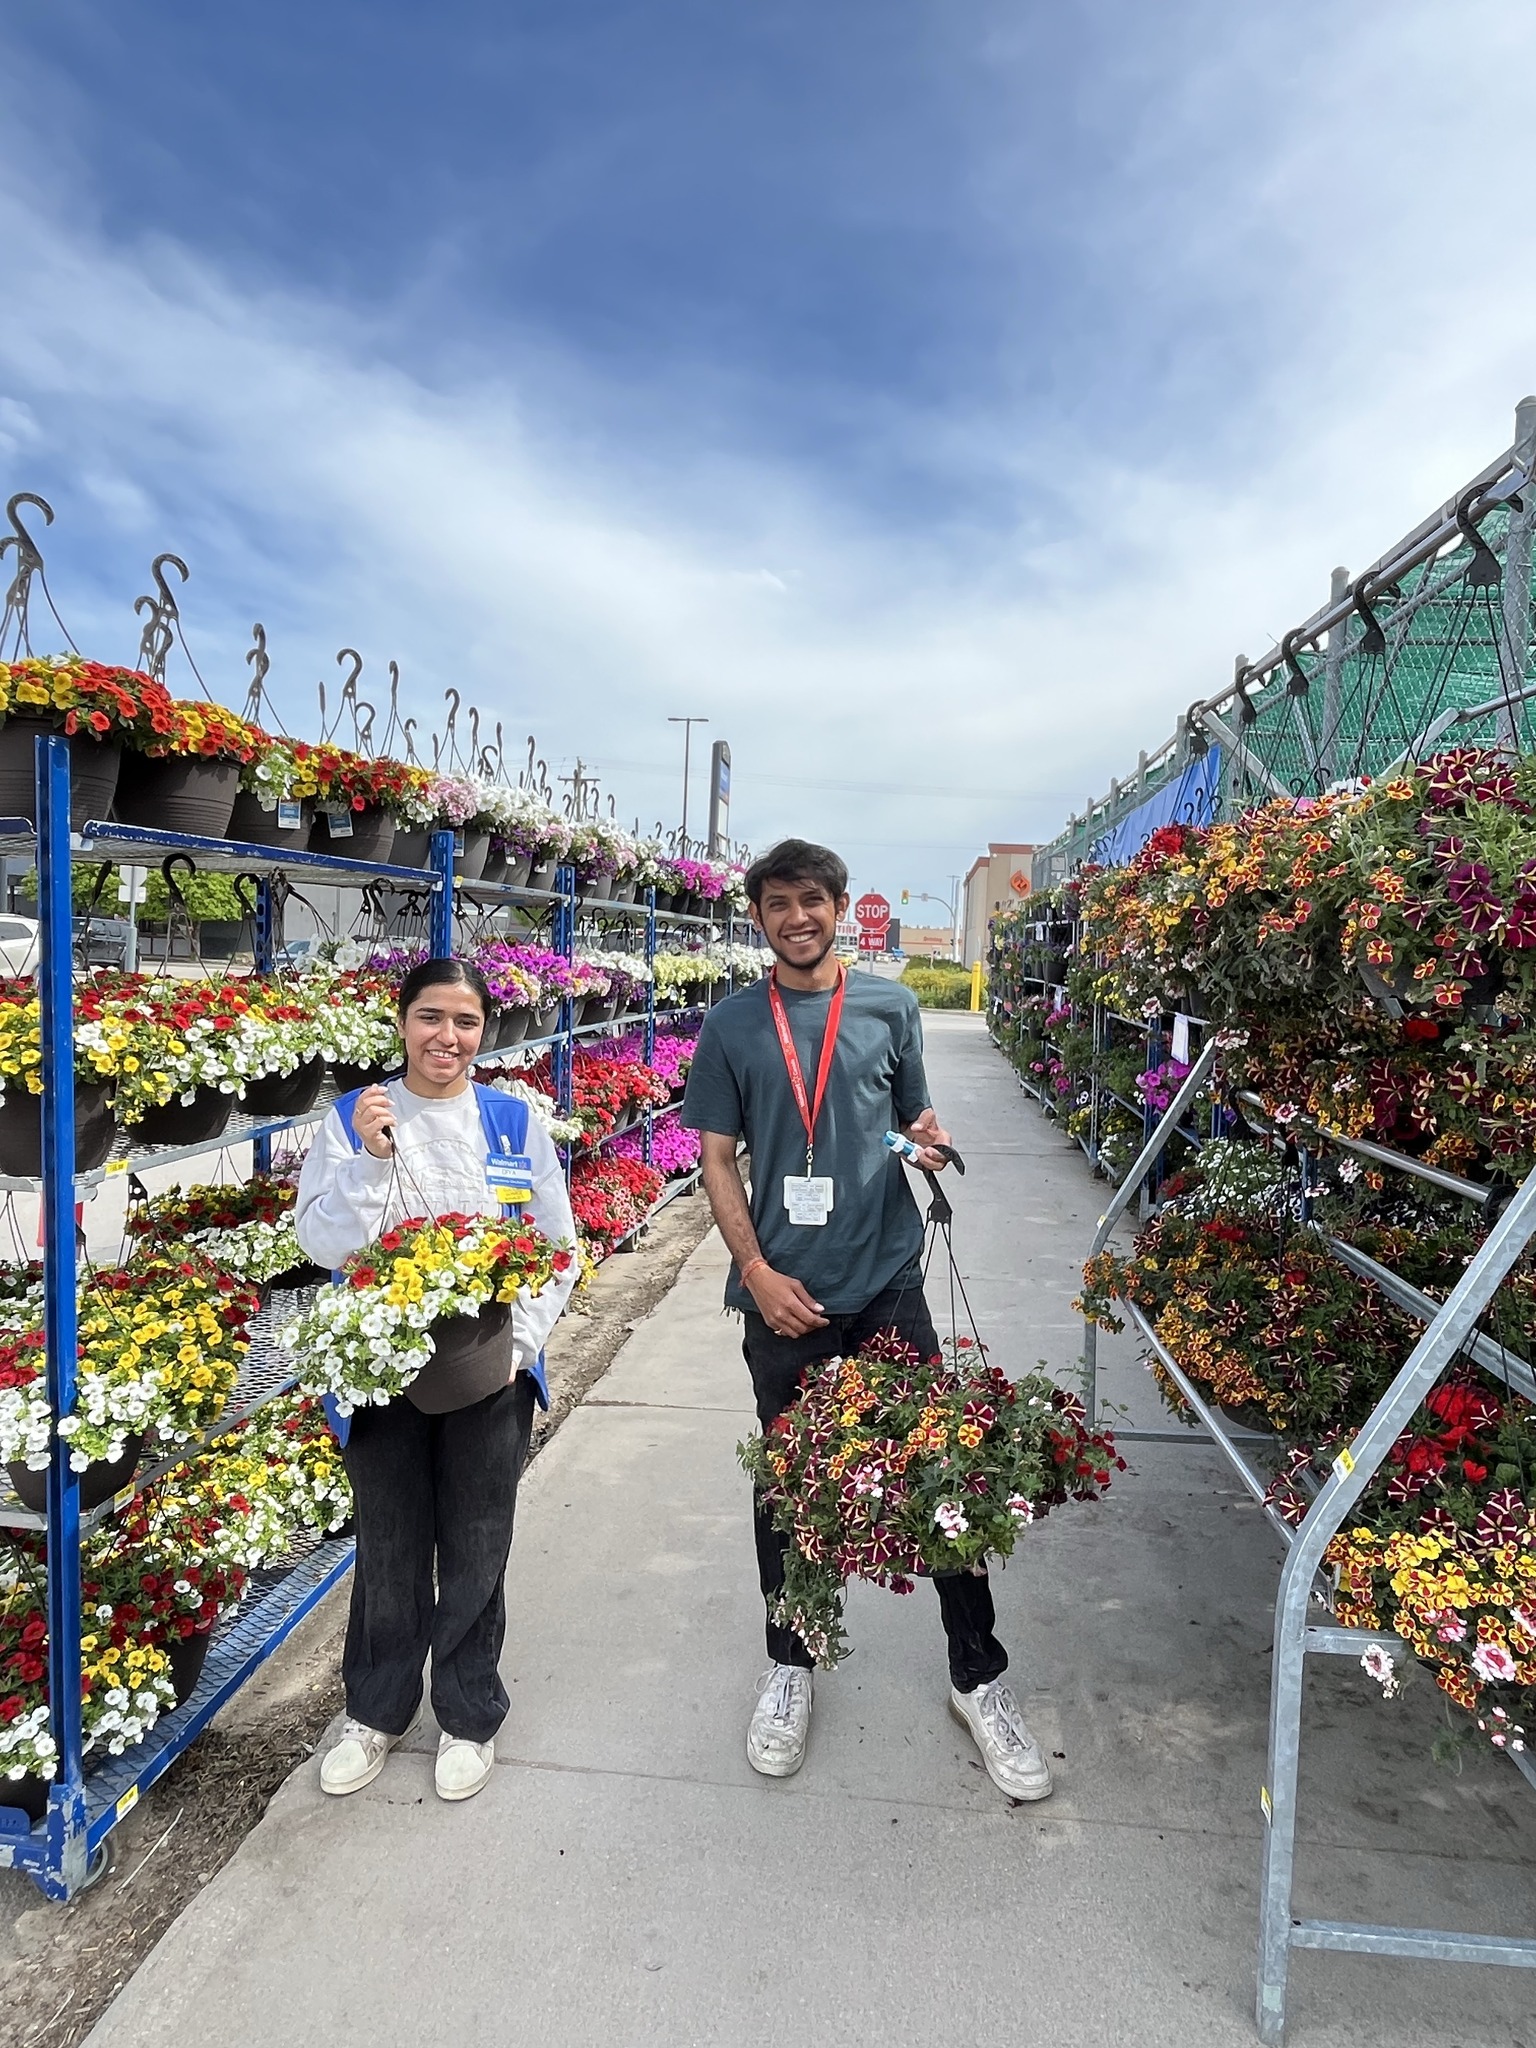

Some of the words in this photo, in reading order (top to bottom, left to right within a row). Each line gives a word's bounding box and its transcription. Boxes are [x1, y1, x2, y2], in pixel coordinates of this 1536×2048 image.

[857, 904, 888, 918] STOP
[860, 937, 866, 946] 4
[868, 937, 884, 947] WAY
[490, 1158, 518, 1167] Walmart
